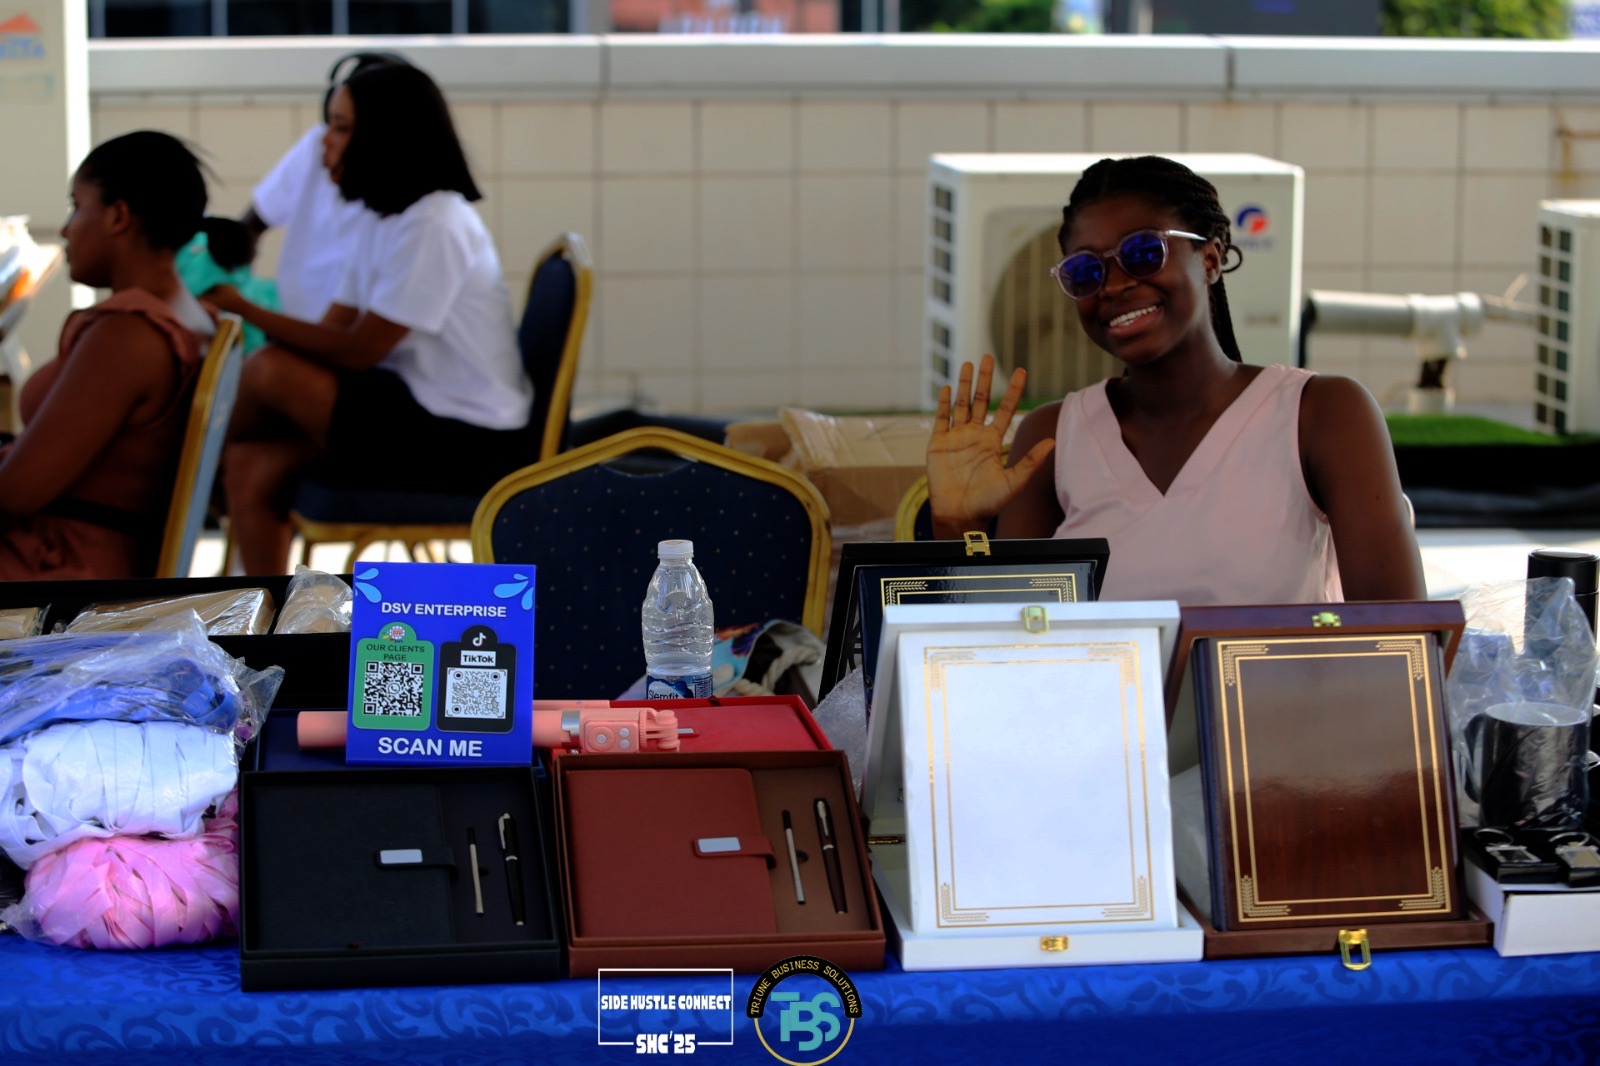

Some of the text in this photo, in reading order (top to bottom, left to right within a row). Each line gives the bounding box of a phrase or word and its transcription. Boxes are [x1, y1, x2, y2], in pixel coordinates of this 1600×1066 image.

[381, 602, 507, 618] DSV ENTERPRISE
[366, 643, 425, 653] OUR CLIENTS
[383, 653, 407, 661] PAGE
[462, 654, 494, 664] TikTok
[378, 736, 483, 757] SCAN ME
